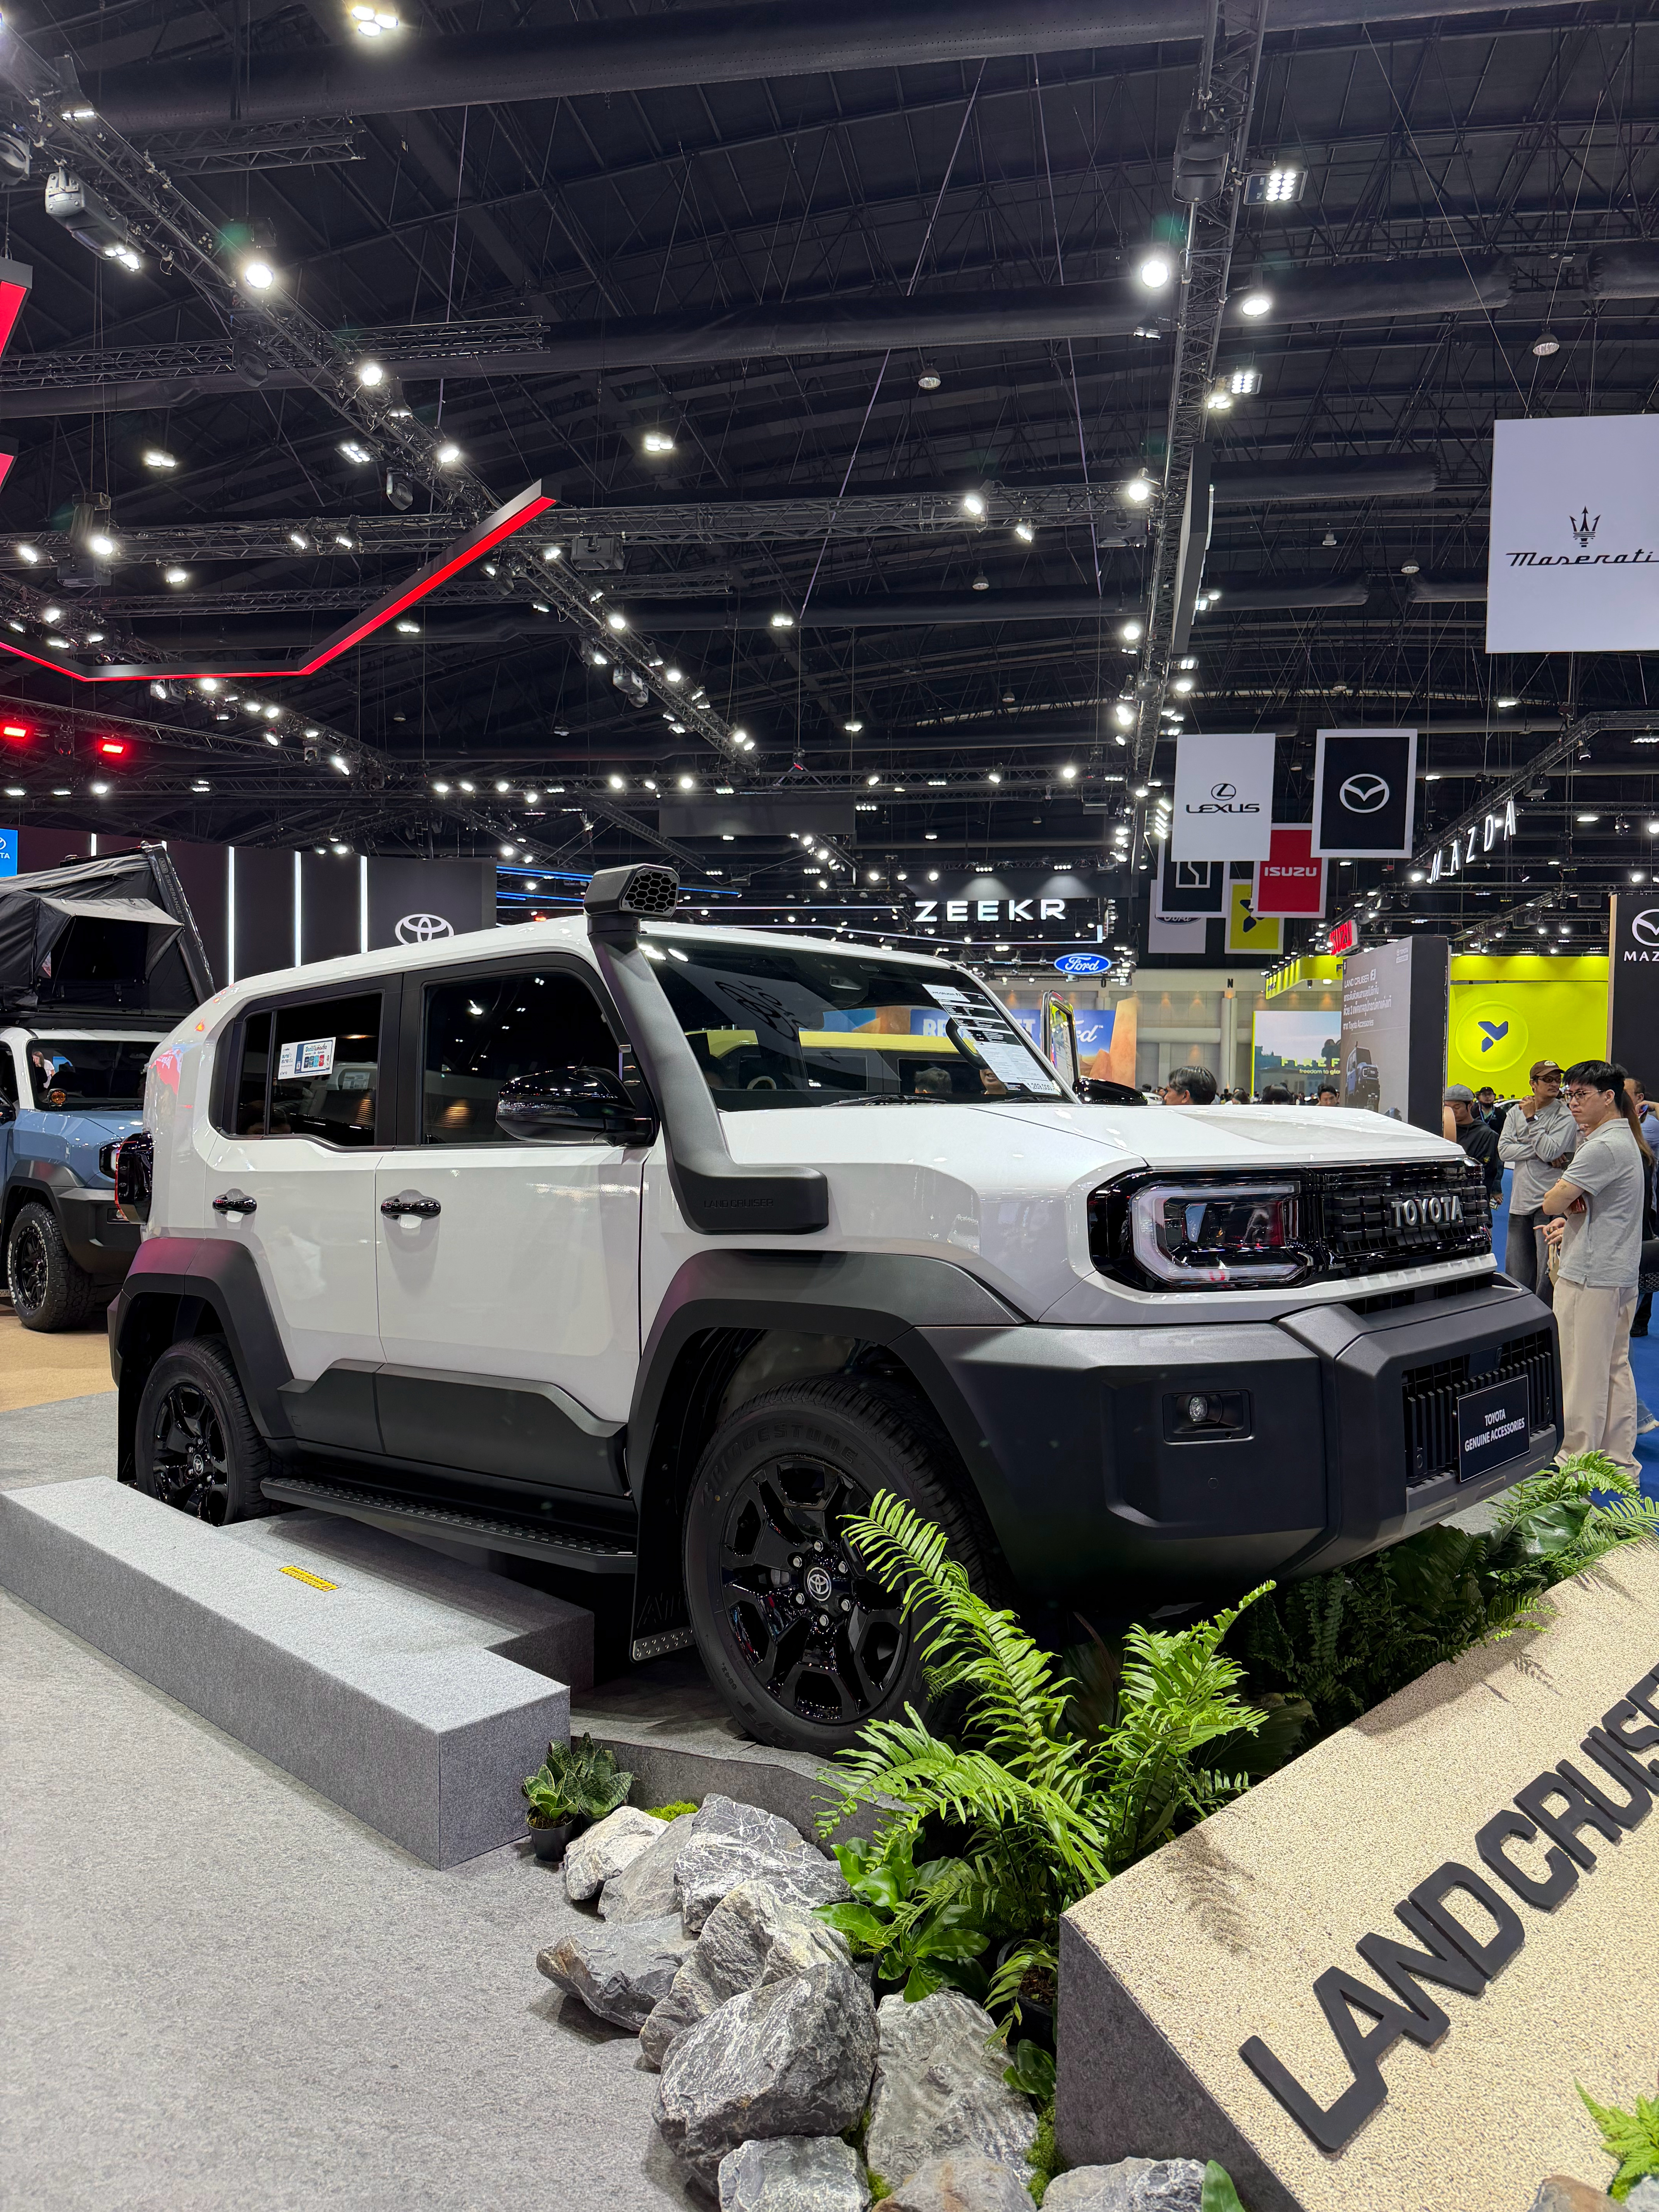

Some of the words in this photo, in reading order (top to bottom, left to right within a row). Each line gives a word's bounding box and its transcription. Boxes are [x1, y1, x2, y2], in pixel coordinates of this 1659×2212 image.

[1506, 549, 1659, 567] Maserati
[1186, 804, 1260, 813] LEXUS
[1430, 800, 1516, 881] MAZDA
[1264, 867, 1317, 877] ISUZU
[914, 899, 1066, 922] ZEEKR
[1065, 956, 1100, 971] Ford
[1227, 979, 1233, 988] N
[1345, 978, 1354, 988] LAND
[704, 1200, 728, 1209] LAND
[731, 1199, 774, 1208] CRUISER
[1390, 1195, 1463, 1228] TOYOTA
[8, 1277, 17, 1304] TOYO
[1484, 1408, 1506, 1426] TOYOTA
[1464, 1433, 1490, 1452] GENUINE
[1490, 1417, 1525, 1442] ACCESSORIES
[1238, 1861, 1525, 2153] LAND
[1475, 1662, 1659, 1915] CRUIS
